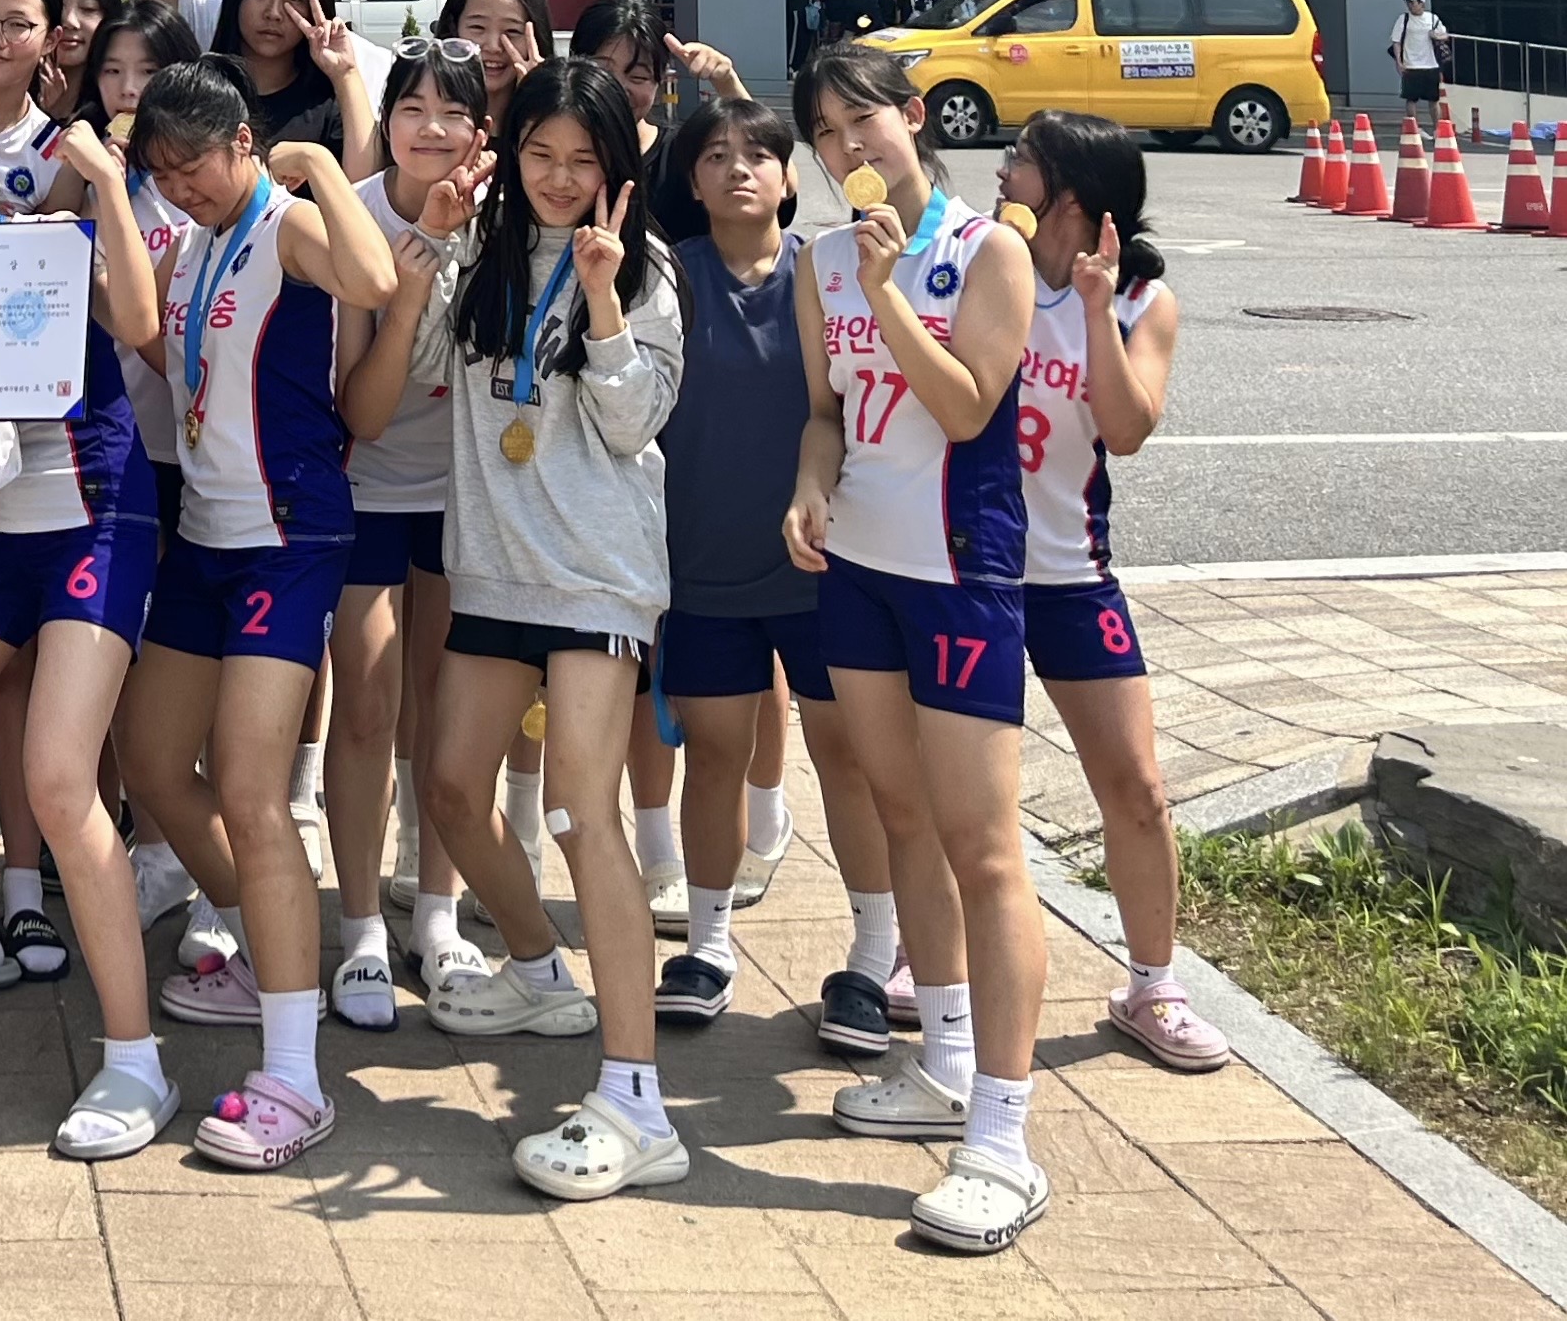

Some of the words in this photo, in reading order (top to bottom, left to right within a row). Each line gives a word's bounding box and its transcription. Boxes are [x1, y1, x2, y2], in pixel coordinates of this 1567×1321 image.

[856, 369, 909, 445] 17
[1018, 405, 1051, 473] 8
[66, 555, 98, 599] 6
[241, 590, 274, 635] 2
[1098, 608, 1132, 654] 8
[933, 634, 987, 689] 17
[342, 967, 389, 986] FILA
[437, 951, 483, 969] FILA
[262, 1136, 305, 1164] crocs
